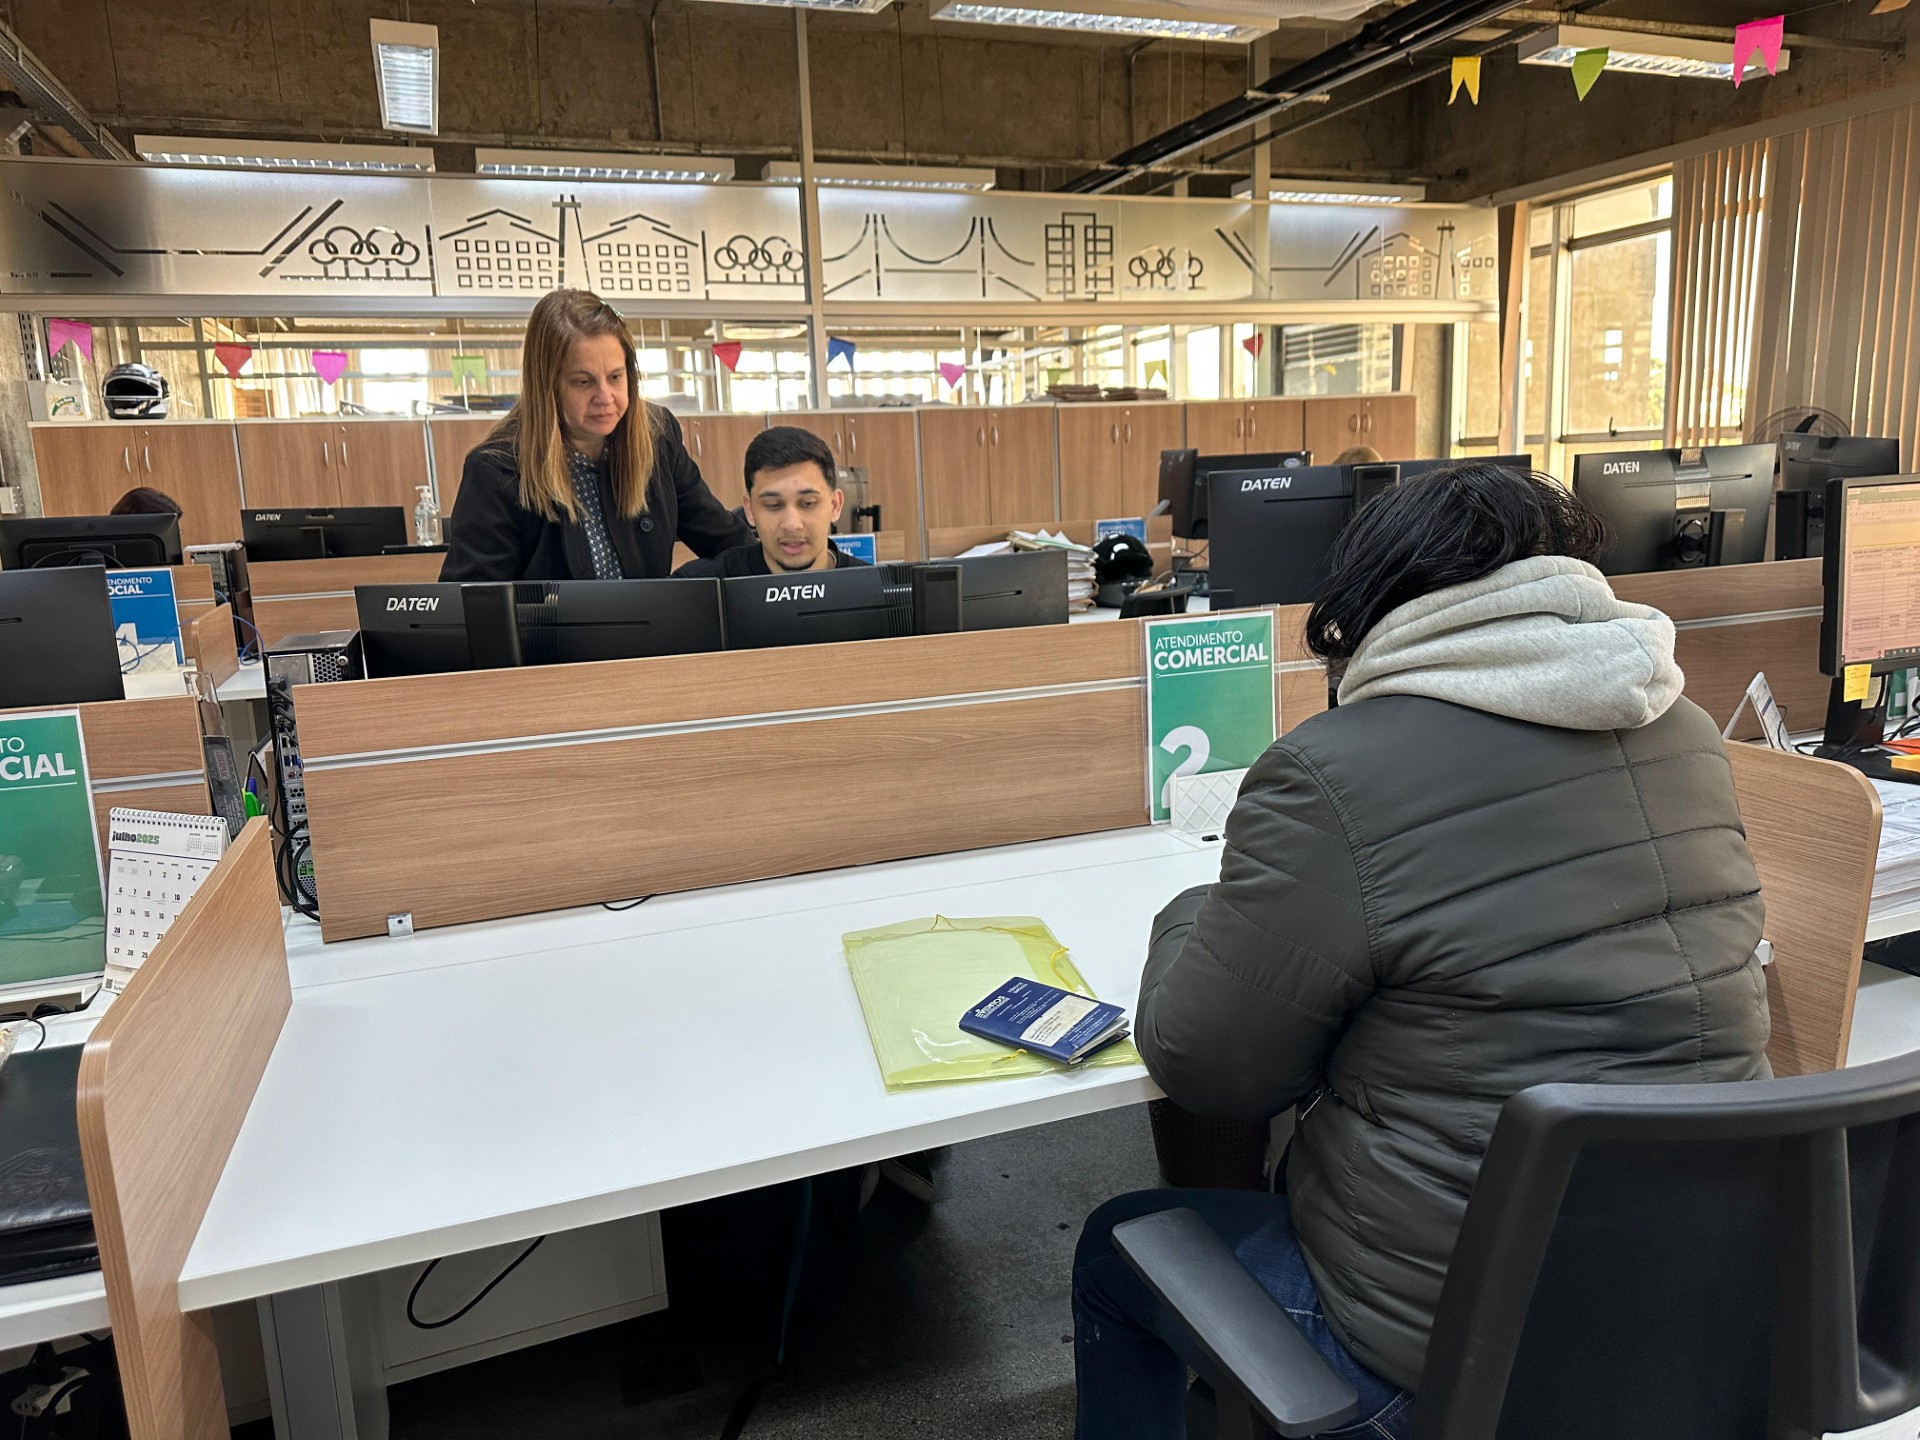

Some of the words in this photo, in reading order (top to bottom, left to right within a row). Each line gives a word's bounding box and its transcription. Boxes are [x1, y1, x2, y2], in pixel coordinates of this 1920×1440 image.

[1603, 461, 1640, 475] DATEN
[1241, 477, 1292, 492] DATEN
[255, 513, 281, 521] DATEN
[106, 576, 153, 586] ENDIMENTO
[107, 584, 144, 596] OCIAL
[765, 584, 825, 602] DATEN
[386, 597, 440, 611] DATEN
[1155, 630, 1243, 650] ATENDIMENTO
[1153, 642, 1269, 671] COMERCIAL
[0, 736, 25, 754] TO
[0, 752, 76, 781] CIAL
